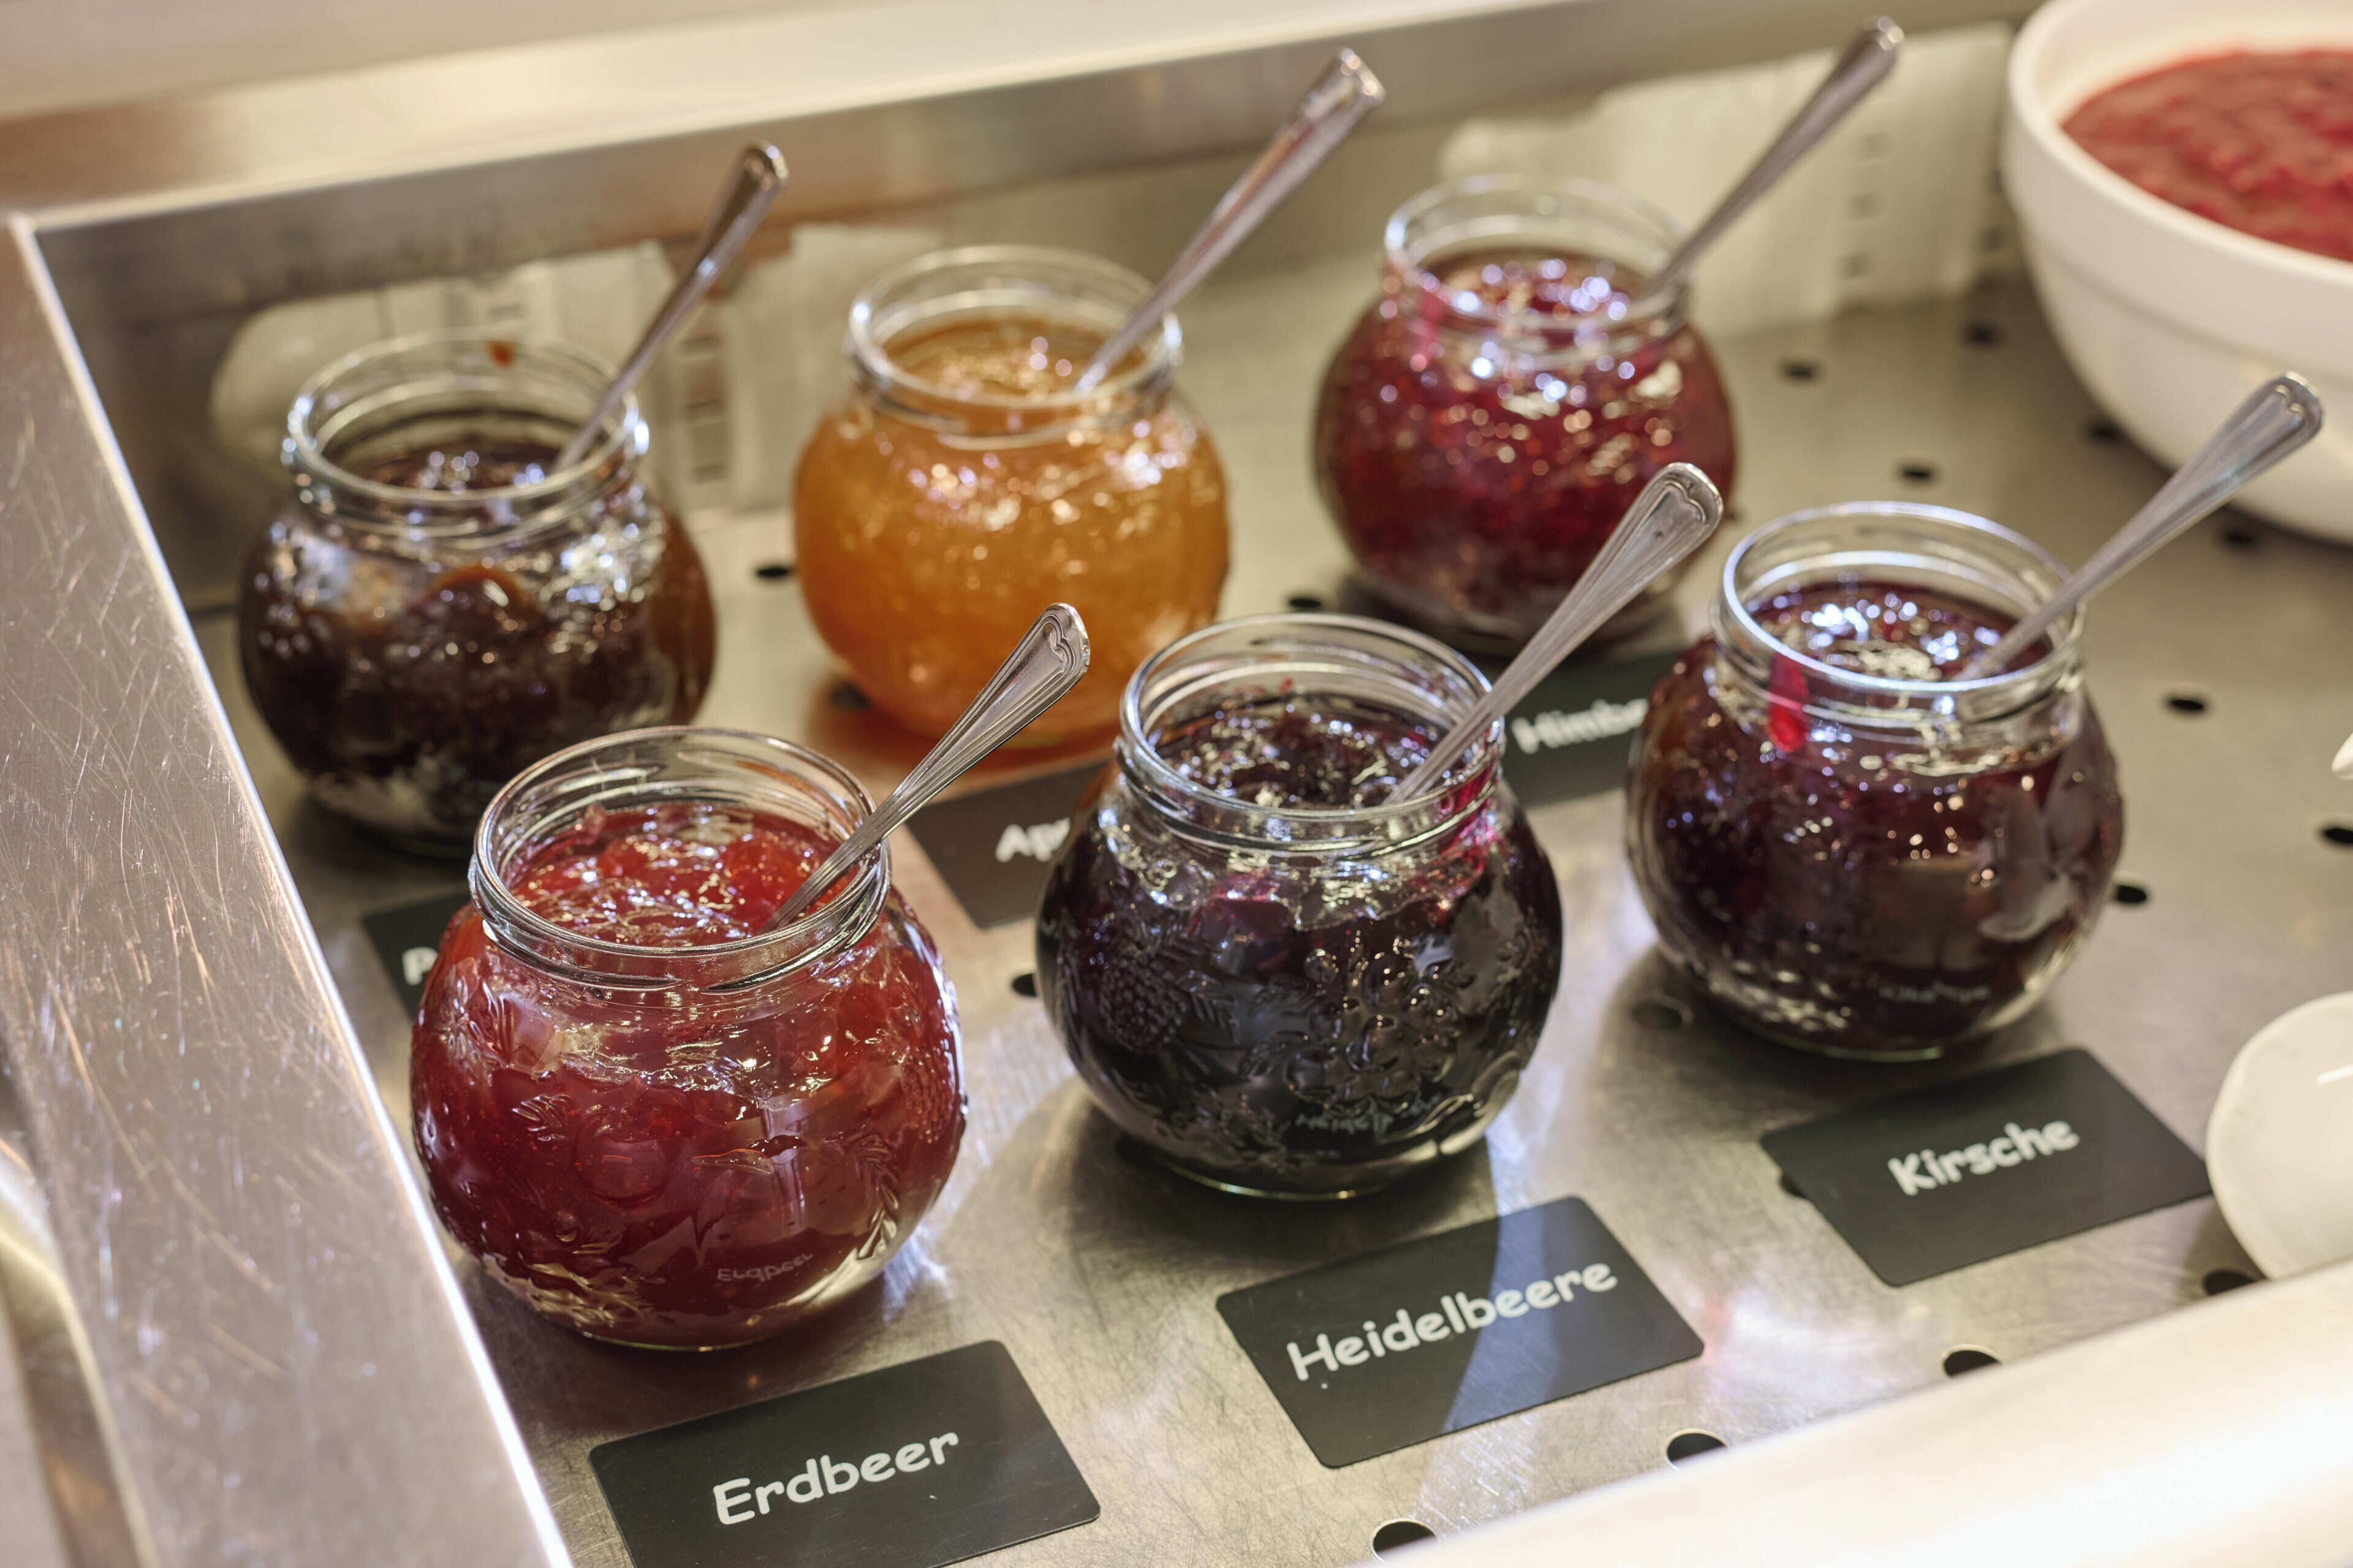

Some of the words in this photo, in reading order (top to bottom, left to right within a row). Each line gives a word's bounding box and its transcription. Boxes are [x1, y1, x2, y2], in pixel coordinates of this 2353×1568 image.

[1888, 1121, 2080, 1197] Kirsche
[1287, 1263, 1618, 1381] Heidelbeere
[713, 1432, 959, 1524] Erdbeer
